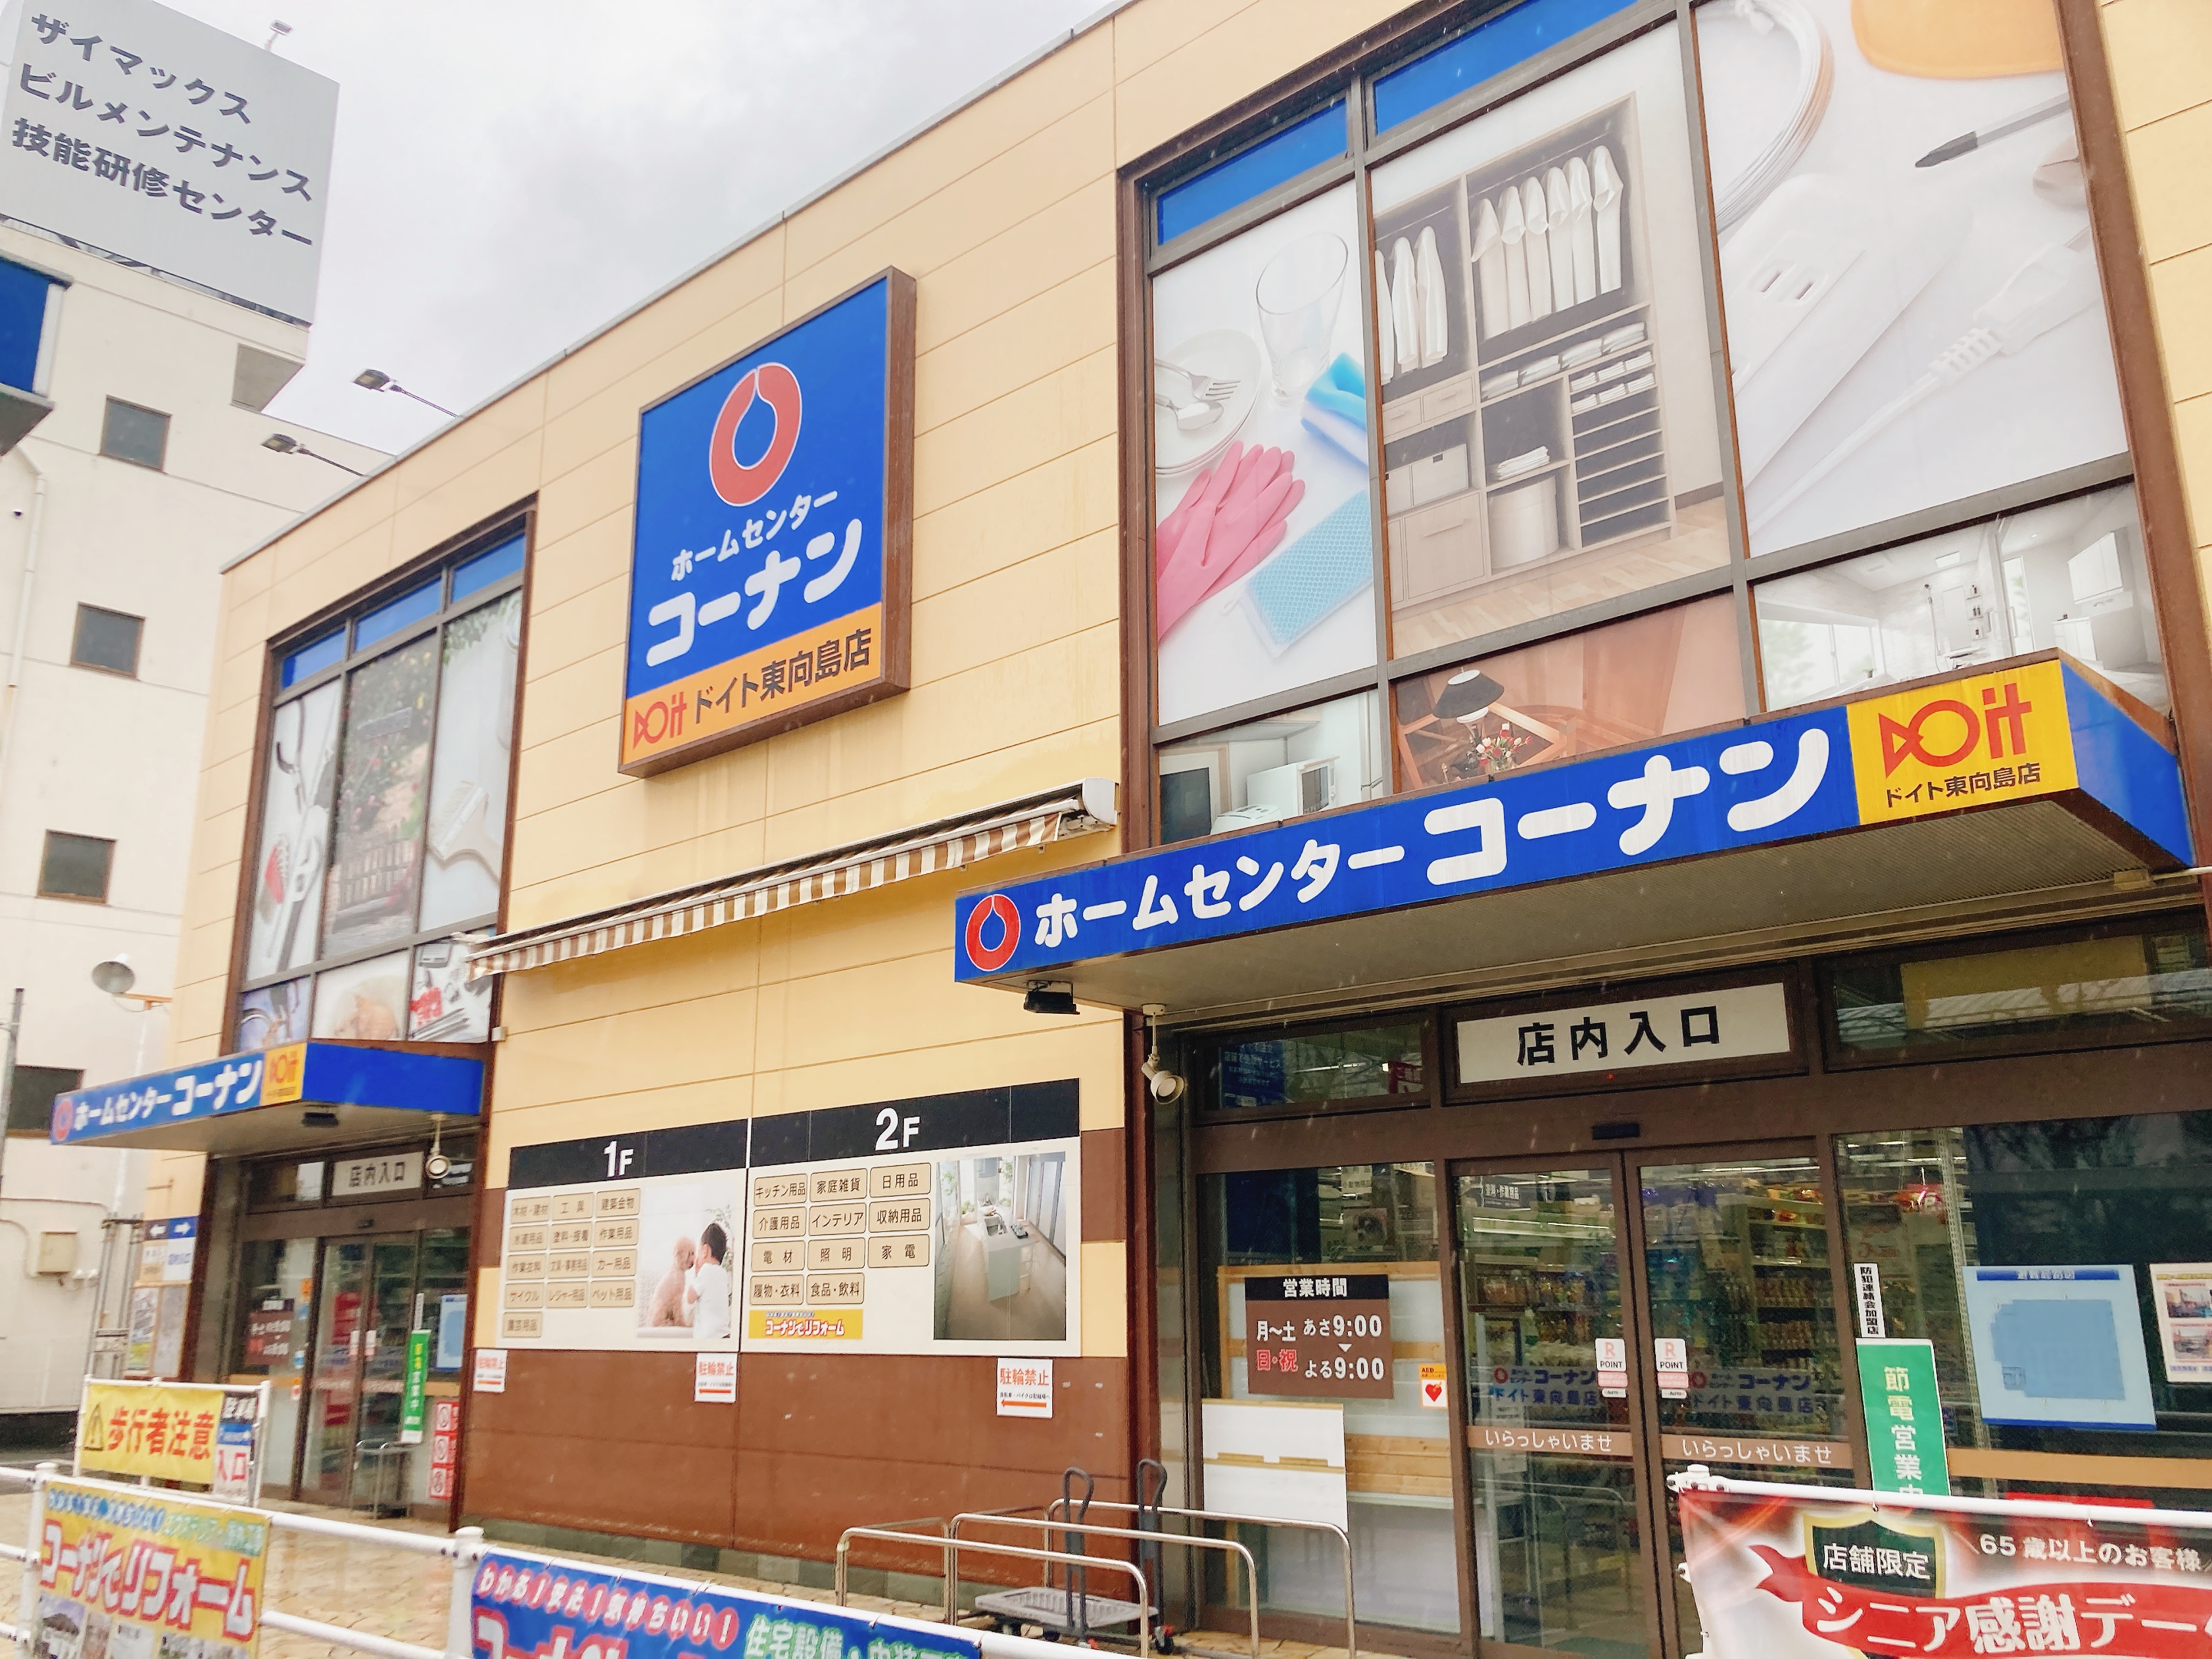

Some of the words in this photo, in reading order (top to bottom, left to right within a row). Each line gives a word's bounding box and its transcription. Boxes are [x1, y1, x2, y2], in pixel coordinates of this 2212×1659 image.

[31, 13, 251, 124] ザイマックス
[21, 63, 313, 201] ビルメンテナンス
[12, 118, 313, 246] 技能研修センター
[672, 491, 837, 581] ホームセンター
[647, 518, 862, 667] コーナン
[696, 628, 871, 724] ドイト東向島店
[1886, 763, 2041, 807] ドイト東向島店
[1035, 839, 1405, 948] ホームセンター
[1424, 728, 1830, 886] コーナン
[1517, 1005, 1720, 1066] 店内入口
[74, 1086, 173, 1131] ホームセンター
[171, 1060, 263, 1116] コーナン
[875, 1108, 921, 1150] 2F
[604, 1141, 634, 1177] 1F
[349, 1161, 406, 1187] 店内入口
[816, 1177, 860, 1194] 家庭雑貨
[882, 1174, 919, 1189] 日用品
[756, 1183, 806, 1199] キッチン用品
[759, 1215, 800, 1230] 介護用品
[812, 1213, 863, 1228] インテリア
[876, 1207, 922, 1224] 収納用品
[882, 1243, 916, 1260] 家電
[810, 1281, 860, 1296] 食品・飲料
[1283, 1278, 1347, 1297] 営業時間
[766, 1320, 845, 1336] コーナンでリフォーム
[1000, 1368, 1049, 1386] 駐輪禁止
[1535, 1369, 1596, 1385] コーナン
[1600, 1360, 1622, 1369] POINT
[1660, 1361, 1684, 1369] POINT
[1738, 1373, 1810, 1391] コーナン
[108, 1406, 215, 1460] 歩行者注意
[1485, 1429, 1612, 1452] いらっしゃいませ
[218, 1449, 247, 1481] 入口
[1682, 1439, 1832, 1465] いらっしゃいませ
[1823, 1543, 1931, 1580] 店舗限定
[41, 1519, 255, 1641] コーナンでリフォーム
[1817, 1587, 2212, 1654] シニア感謝デー
